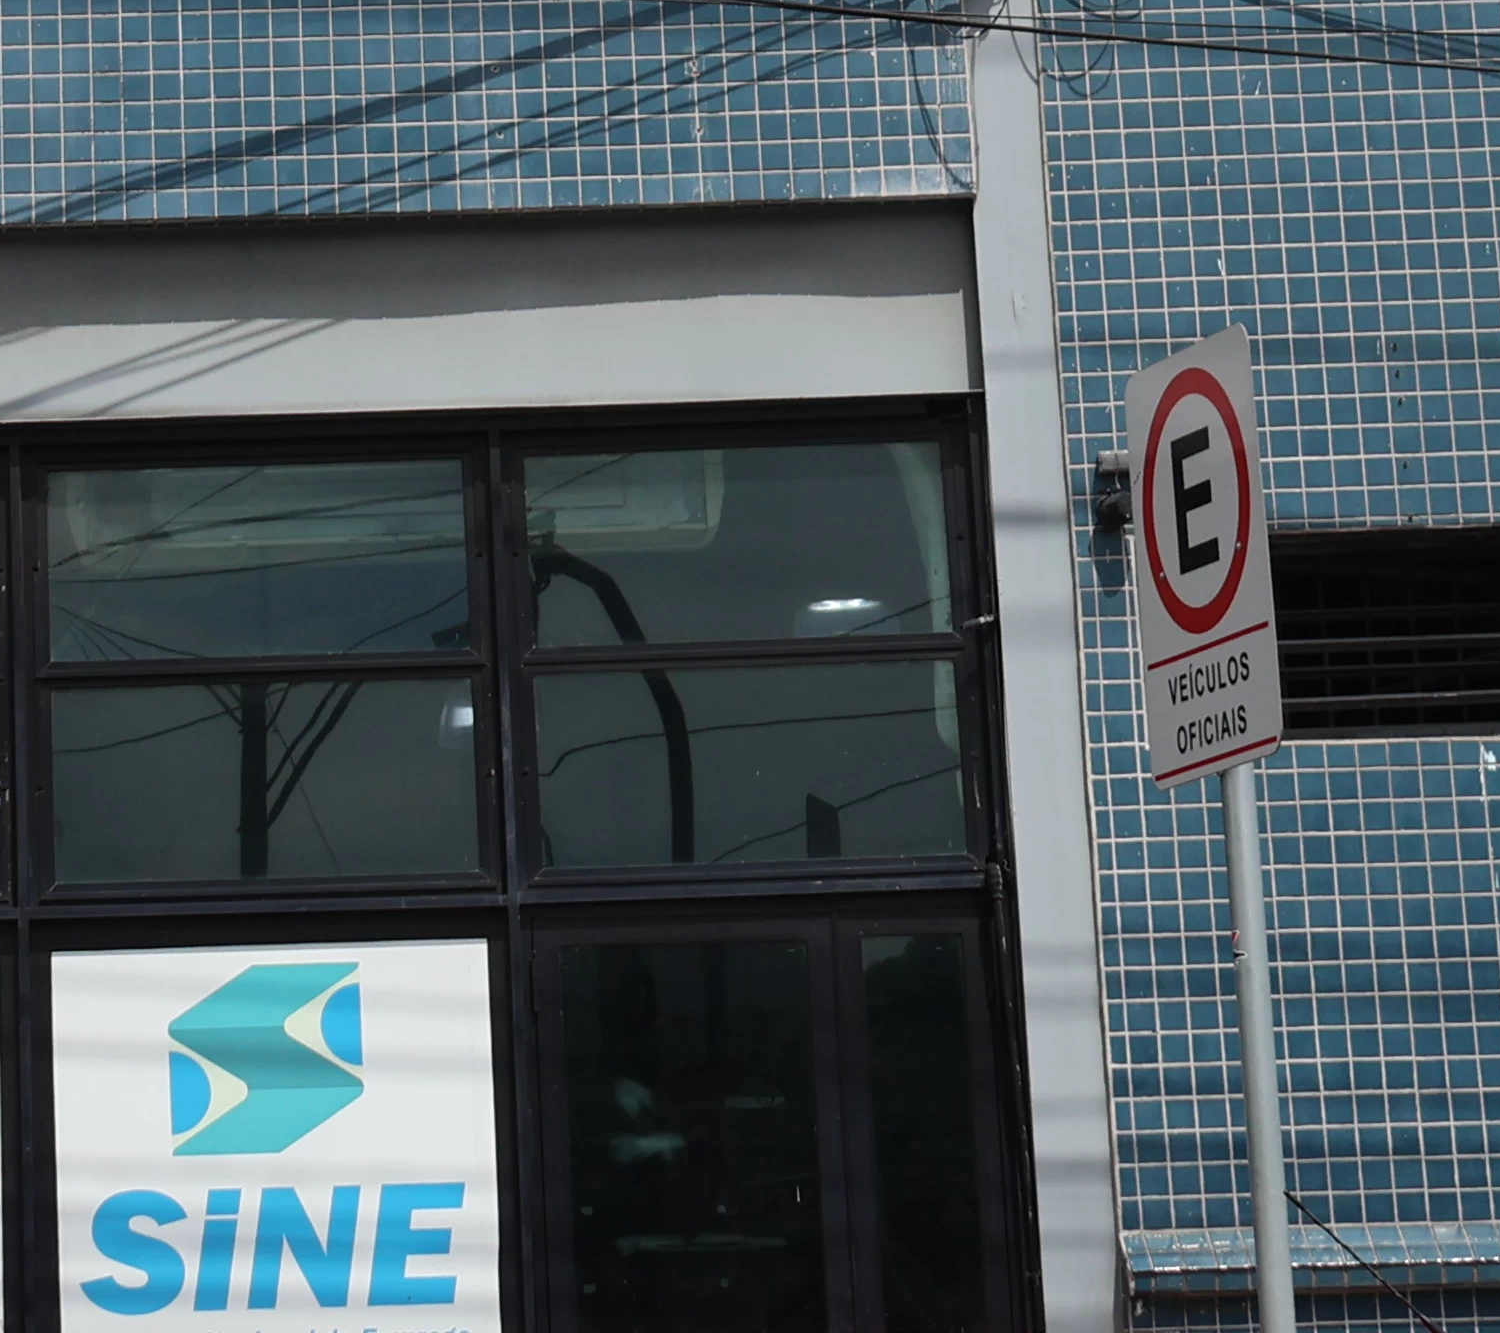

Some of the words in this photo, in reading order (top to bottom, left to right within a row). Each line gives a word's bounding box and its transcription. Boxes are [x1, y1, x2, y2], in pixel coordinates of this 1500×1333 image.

[1170, 425, 1220, 576] E
[1167, 651, 1250, 706] VEÍCULOS
[1176, 704, 1248, 754] OFICIAIS
